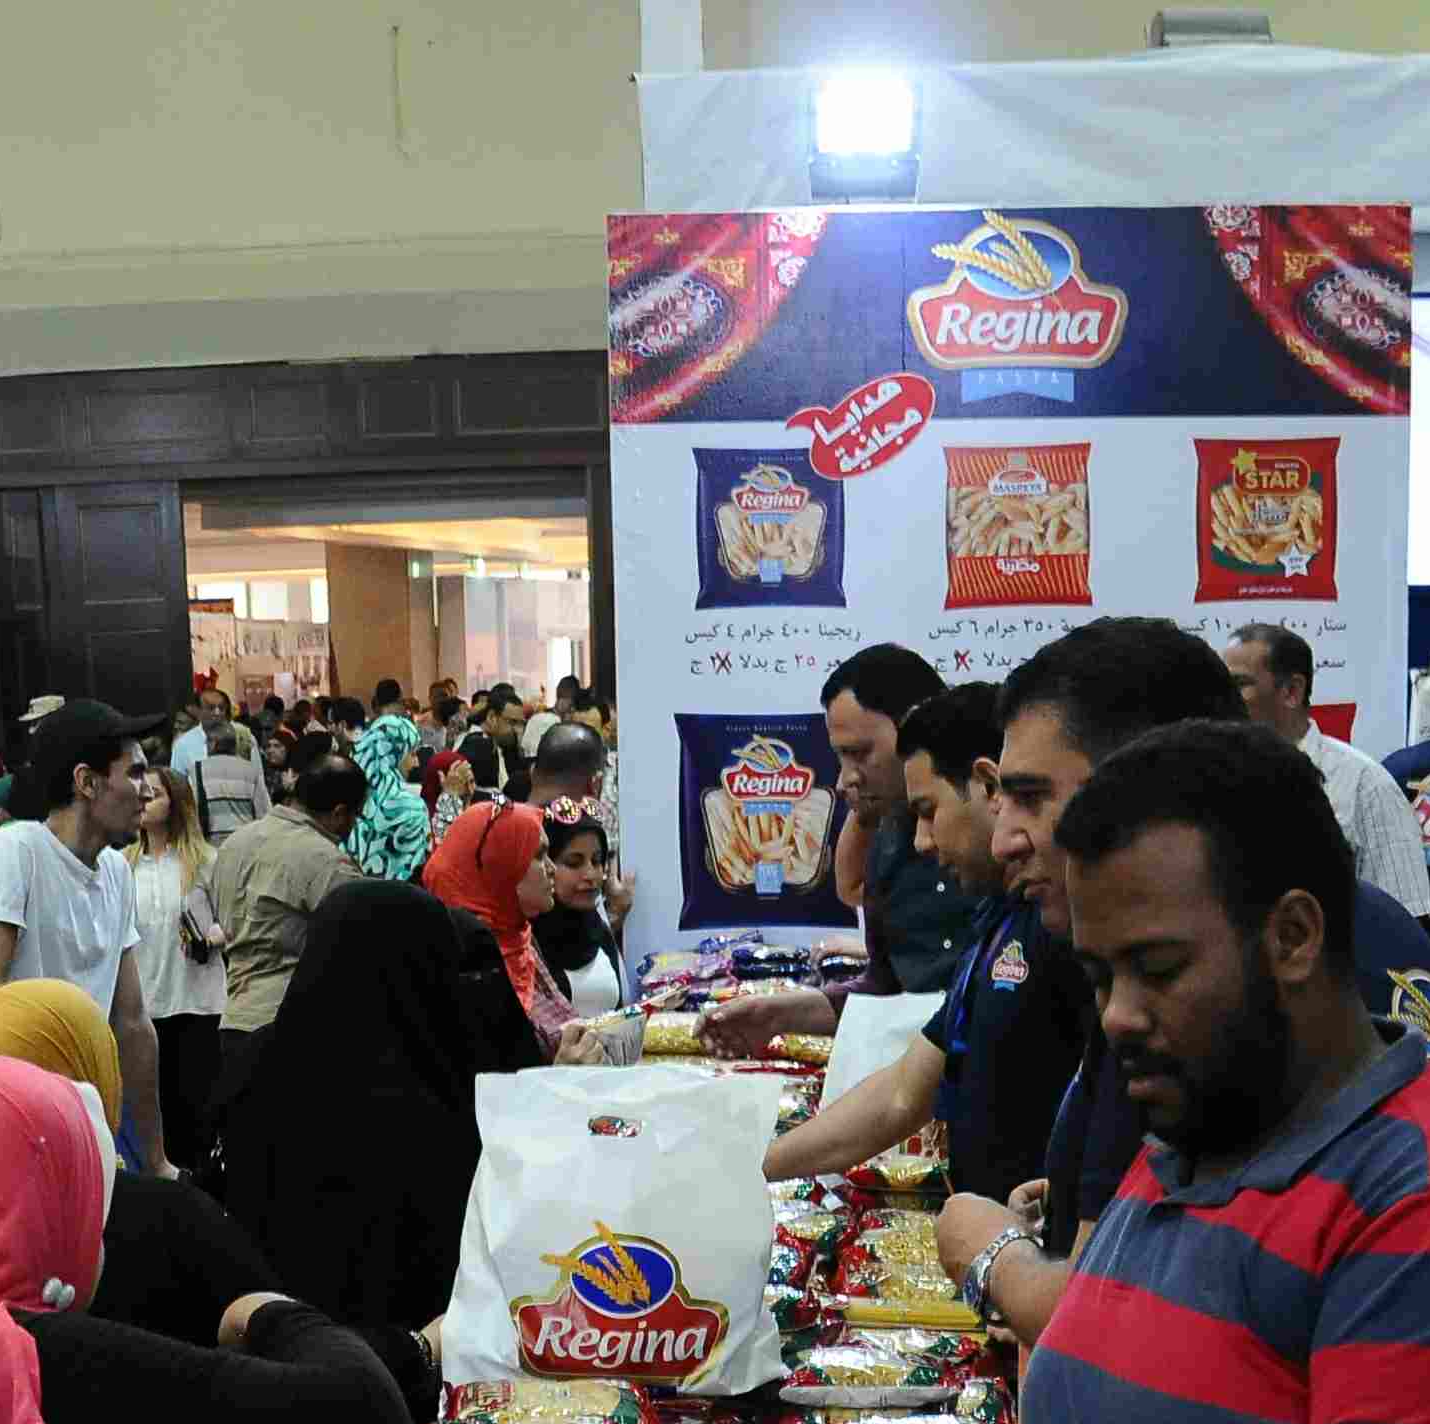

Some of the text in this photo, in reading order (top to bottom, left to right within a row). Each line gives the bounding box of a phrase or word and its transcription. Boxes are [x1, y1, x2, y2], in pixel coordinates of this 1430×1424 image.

[935, 302, 1102, 352] Regina
[978, 372, 1060, 385] PASTA
[813, 381, 903, 446] هدايا
[834, 408, 924, 473] مجانية
[1244, 470, 1300, 489] STAR
[740, 492, 802, 511] Regina
[684, 622, 862, 644] ريجينا ٤٠٠ جرام ٤ كيس
[928, 619, 963, 641] كيس
[984, 619, 1018, 640] جرام
[1317, 616, 1347, 637] ستار
[739, 653, 769, 672] بدلا
[732, 773, 804, 796] Regina
[532, 1315, 708, 1368] Regina
